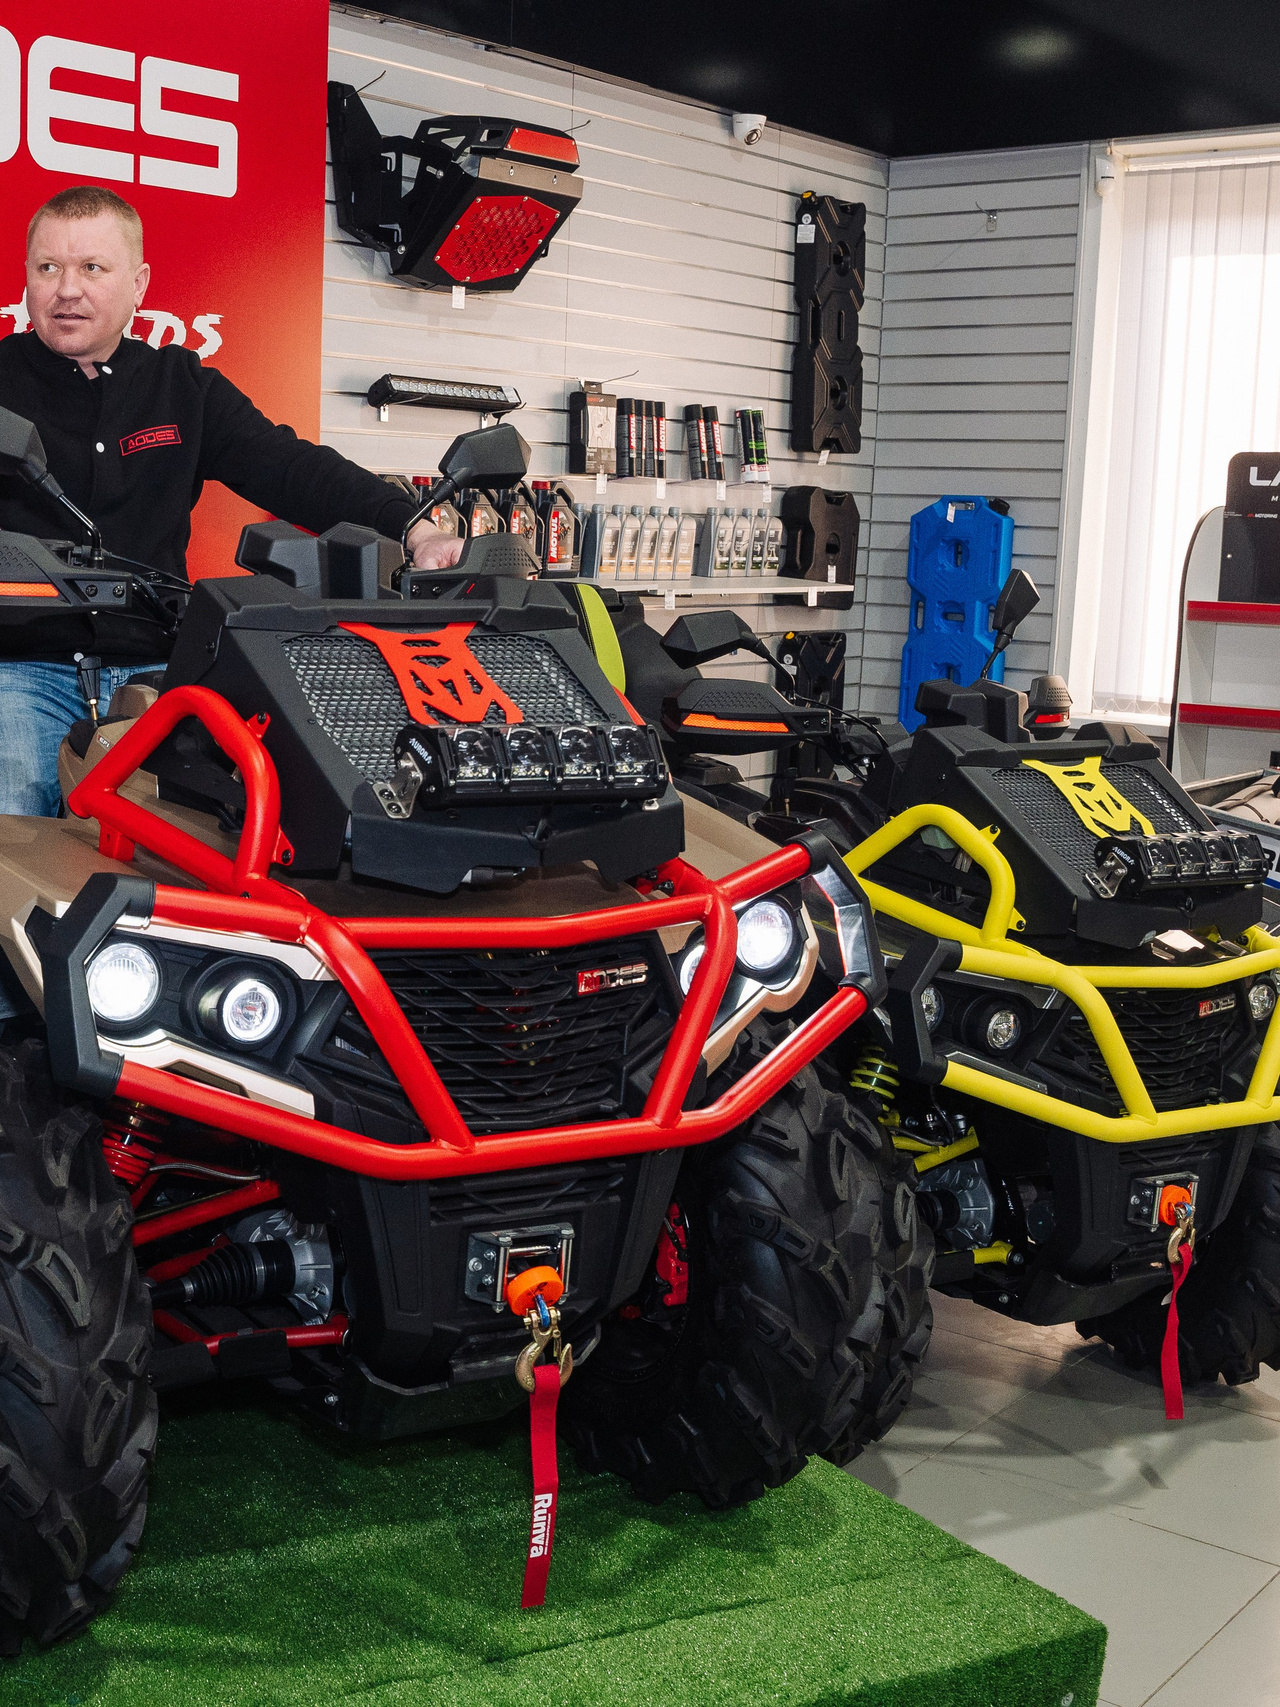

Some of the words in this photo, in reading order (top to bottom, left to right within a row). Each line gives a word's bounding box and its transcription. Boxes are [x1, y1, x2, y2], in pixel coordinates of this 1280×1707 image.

[127, 429, 176, 450] AODES
[550, 517, 558, 559] MOTUL
[408, 737, 433, 764] AURORA
[1112, 846, 1135, 866] AURORA
[578, 963, 649, 993] AODES
[529, 1493, 552, 1558] Runva
